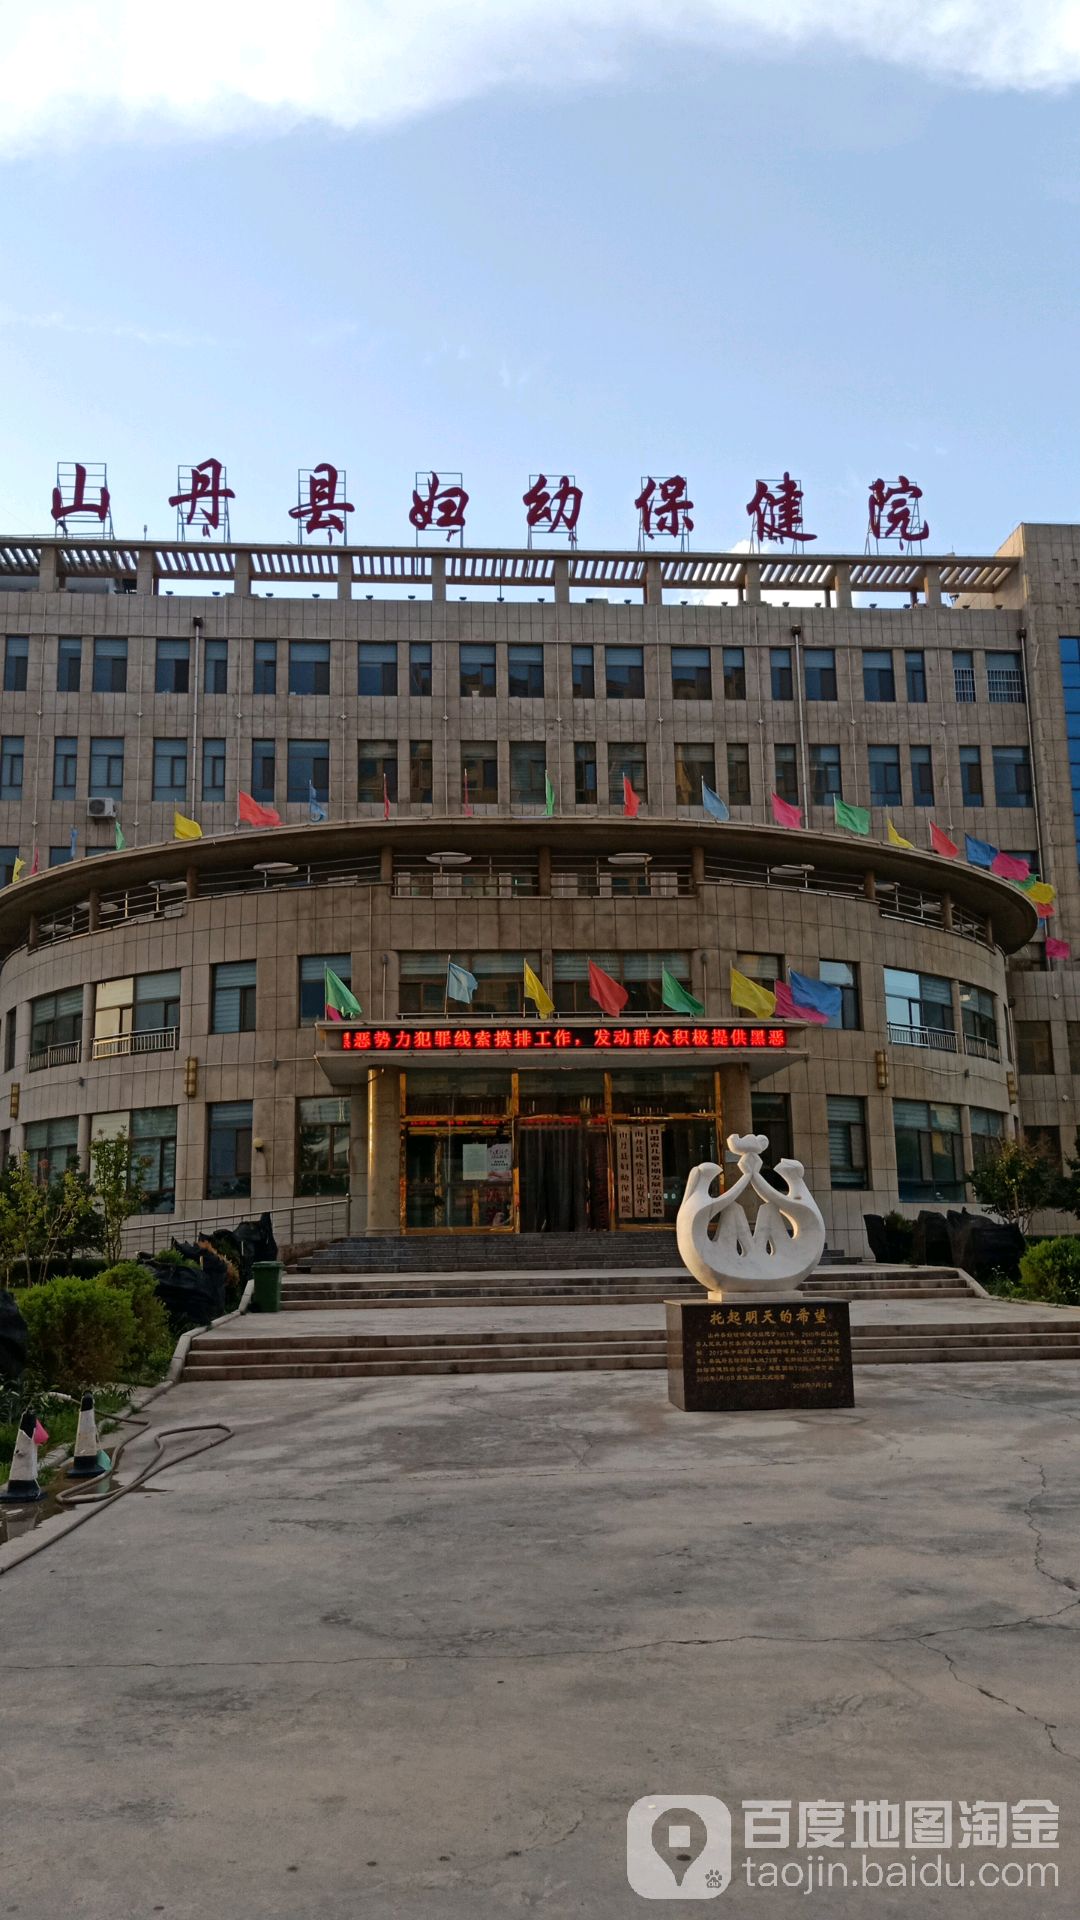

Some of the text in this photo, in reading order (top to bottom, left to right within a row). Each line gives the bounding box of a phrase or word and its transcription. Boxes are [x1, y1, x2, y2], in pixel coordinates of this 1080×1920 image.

[51, 458, 929, 541] 山丹县妇幼保健院
[709, 1308, 828, 1326] 托起明天的希望
